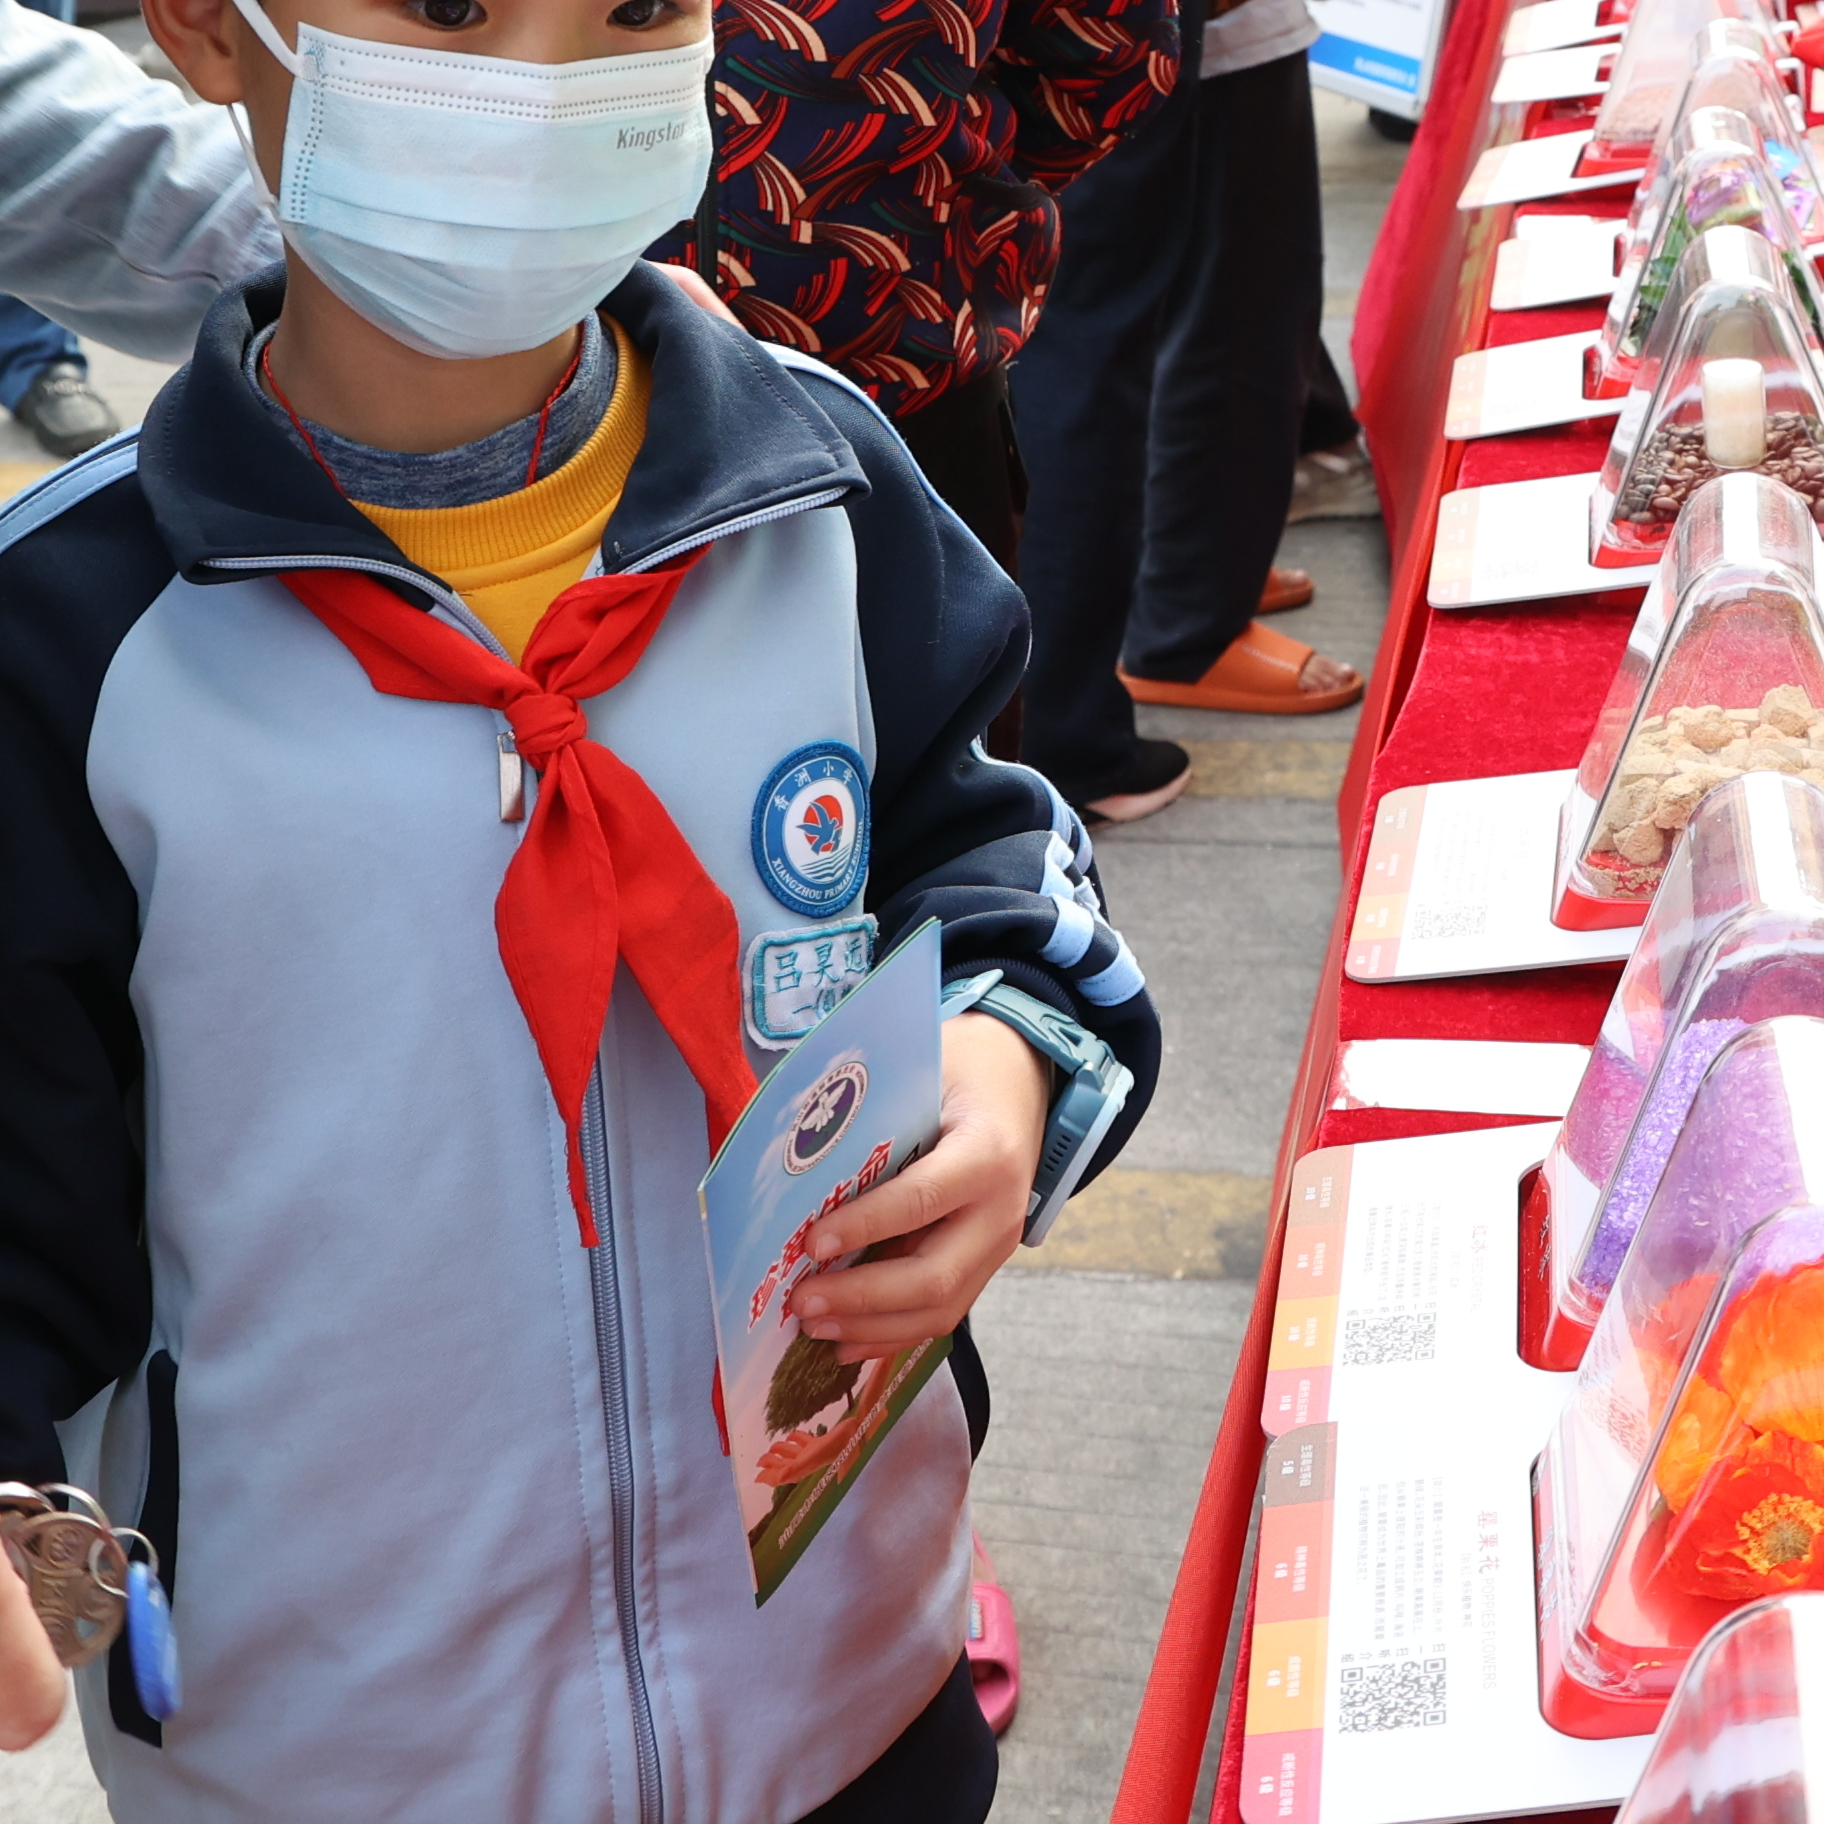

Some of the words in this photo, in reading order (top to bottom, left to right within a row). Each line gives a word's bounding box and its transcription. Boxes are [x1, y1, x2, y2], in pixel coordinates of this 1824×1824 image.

[772, 858, 823, 900] XIANGZHOU
[824, 868, 853, 898] PRIMARY
[773, 937, 866, 994] 吕昊远
[1476, 1510, 1500, 1574] 罂粟花
[1480, 1578, 1495, 1628] POPPIES
[1481, 1631, 1497, 1690] FLOWERS
